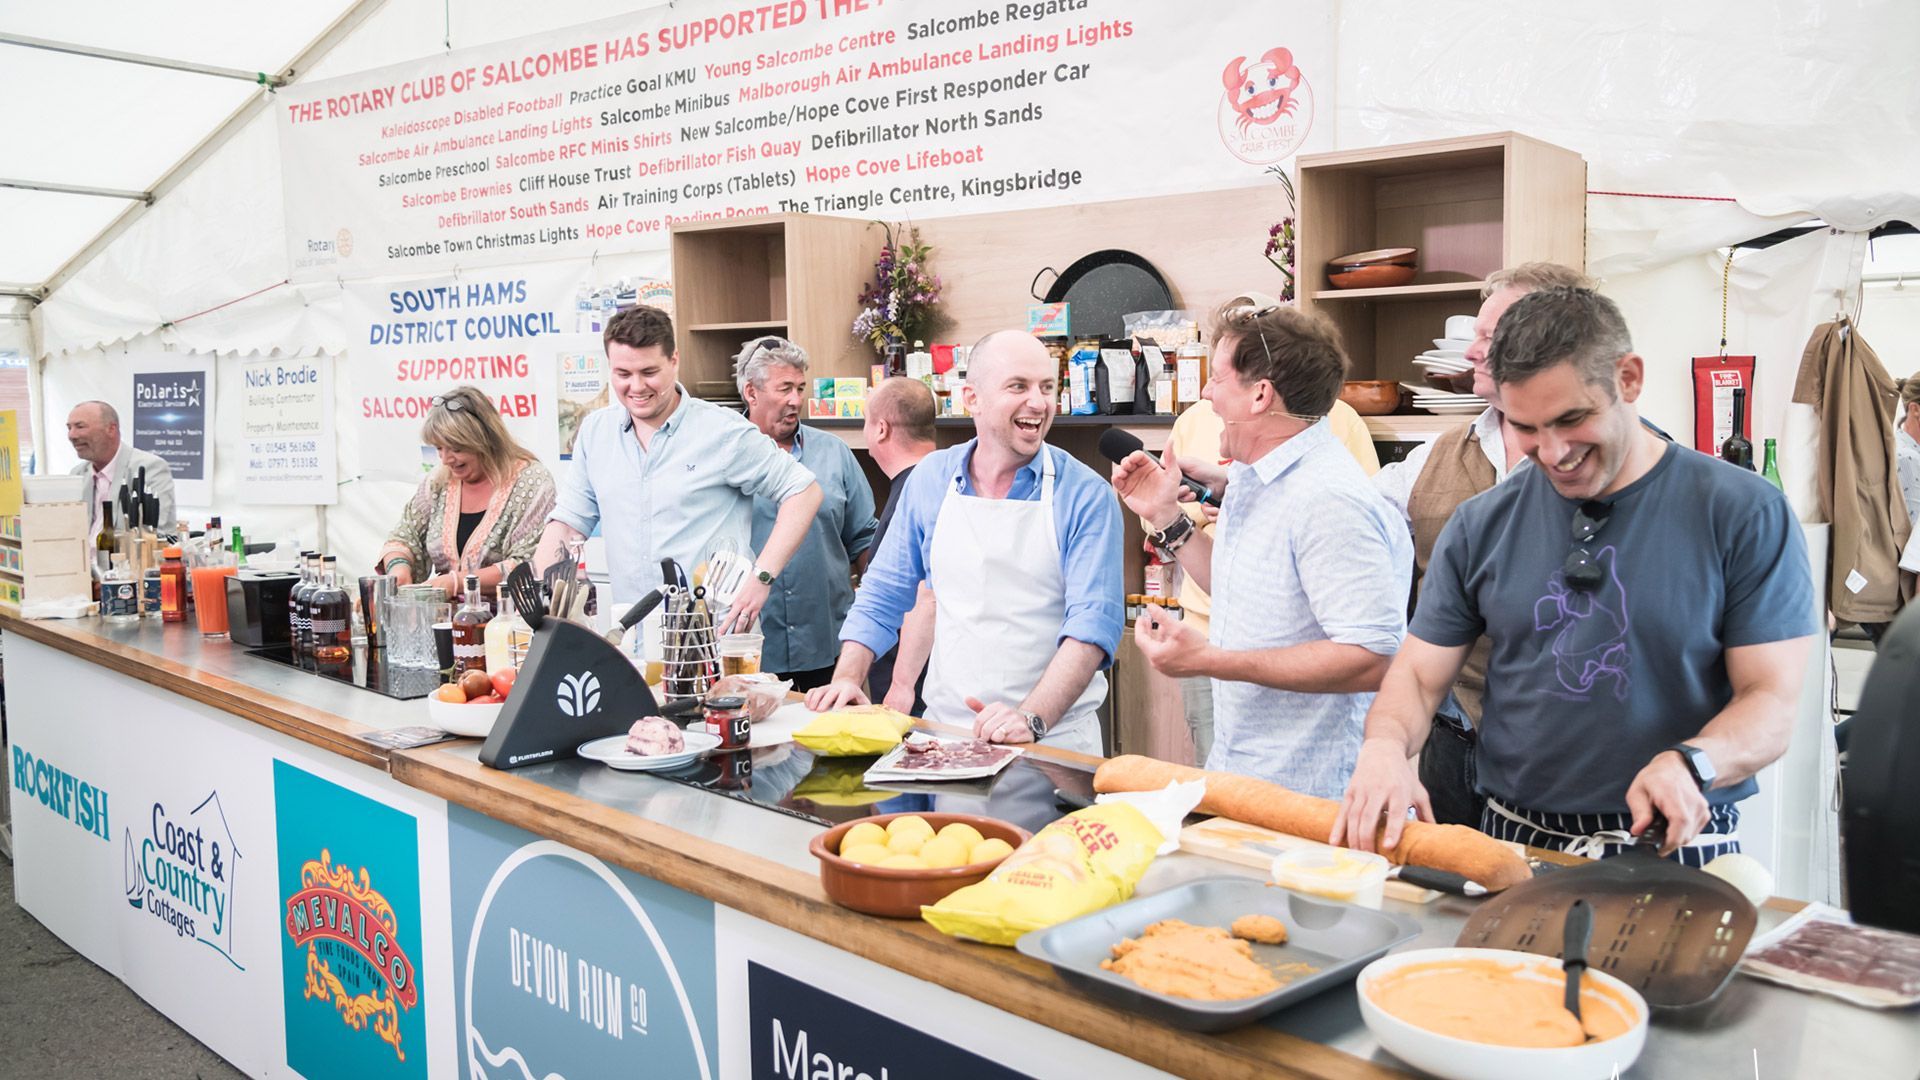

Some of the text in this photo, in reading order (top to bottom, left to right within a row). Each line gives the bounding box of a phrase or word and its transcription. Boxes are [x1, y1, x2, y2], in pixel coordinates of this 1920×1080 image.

[289, 102, 322, 123] THE
[327, 87, 395, 118] ROTARY
[402, 76, 445, 104] CLUB
[451, 68, 476, 93] OF
[483, 44, 597, 86] SALCOMBE
[606, 33, 649, 64] HAS
[658, 0, 806, 52] SUPPORTED
[359, 20, 1133, 166] Salcombe Air Ambulance Landing Lights Salcombe Minibus Malborough Air Ambulance Landing Lights
[382, 0, 1087, 138] Kaleidoscope Disabled Football Practice Goal KMU Young Salcombe Centre Salcombe Regatta
[379, 64, 1089, 187] Salcombe Preschool Salcombe RFC Minis Shirts New Salcombe/Hope Cove First Responder Car
[402, 103, 1042, 208] Salcombe Brownies Cliff House Trust Defibrillator Fish Quay Defibrillator North Sands
[388, 242, 440, 258] Salcombe
[444, 240, 472, 252] Town
[476, 233, 535, 249] Christmas
[540, 227, 578, 244] Lights
[587, 224, 622, 239] Hope
[627, 219, 660, 233] Cove
[779, 199, 809, 213] The
[815, 190, 883, 211] Triangle
[890, 185, 954, 204] Centre,
[962, 169, 1081, 196] Kingsbridge
[439, 145, 983, 228] Defibrillator South Sands Air Training Corps (Tablets) Hope Cove Lifeboat
[370, 312, 560, 345] DISTRICT COUNCIL
[390, 280, 527, 313] SOUTH HAMS
[136, 383, 187, 399] Polaris
[246, 365, 318, 388] Nick Brodie
[363, 397, 433, 419] SALCOM
[397, 354, 529, 381] SUPPORTING
[734, 720, 750, 736] LC
[12, 743, 111, 842] ROCKFISH
[152, 802, 225, 882] Coast &
[141, 838, 226, 936] Country
[146, 888, 197, 938] Cottages
[291, 894, 408, 992] MEVALCO
[318, 941, 334, 957] FINE
[338, 963, 360, 988] SPAIN
[510, 926, 648, 1041] DEVON RUM CO
